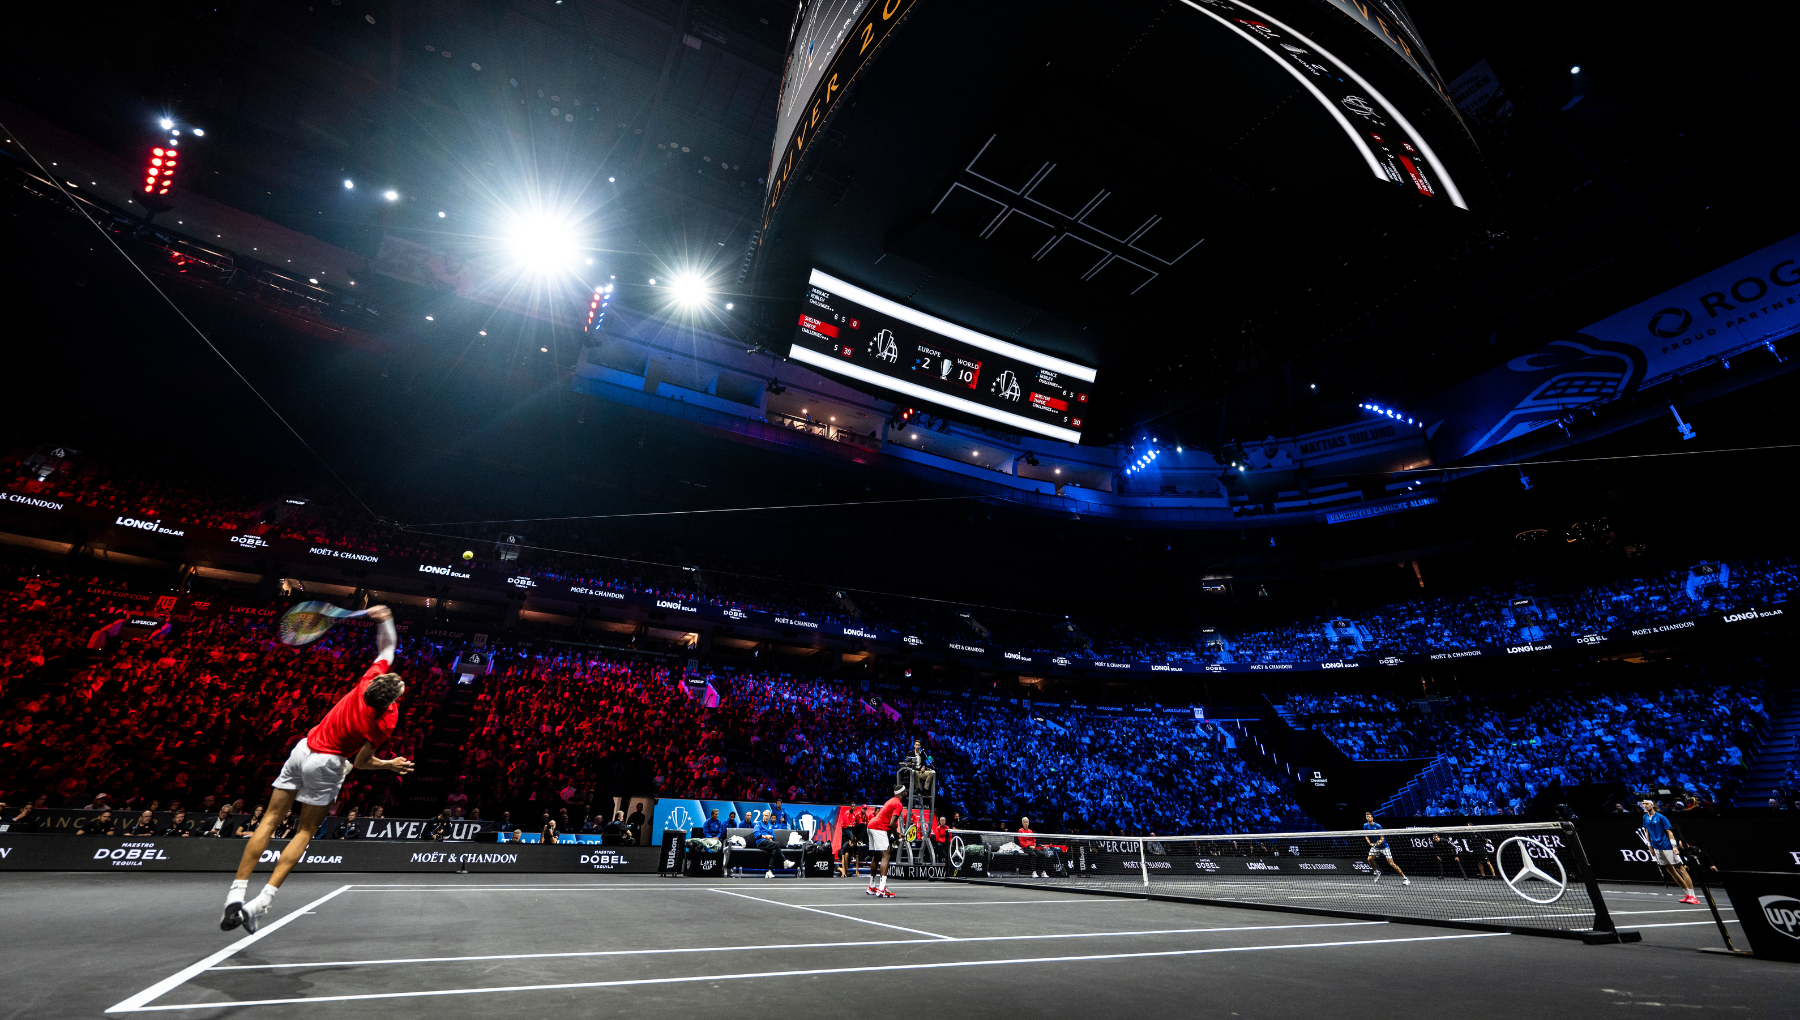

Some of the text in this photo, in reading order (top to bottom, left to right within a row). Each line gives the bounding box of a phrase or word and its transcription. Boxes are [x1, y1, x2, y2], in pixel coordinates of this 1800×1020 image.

[1661, 294, 1800, 354] PROUD PARTNE
[843, 348, 851, 356] 30
[917, 345, 942, 358] EUROPE
[921, 357, 972, 382] 2 10
[957, 358, 979, 370] WORLD
[1300, 425, 1395, 456] MATTIAS OHLUND
[9, 494, 64, 511] CHANDON
[1330, 496, 1438, 521] VANCOUVER CANUCKS ALUMNI
[158, 528, 184, 536] SOLAR
[230, 536, 268, 547] DOBEL
[309, 547, 333, 556] MOËT
[340, 552, 379, 563] CHANDON
[507, 577, 536, 587] DOBEL
[87, 587, 111, 596] LAVER
[594, 590, 624, 599] CHANDON
[160, 598, 175, 607] 115
[229, 605, 276, 617] LAVER CUP
[1760, 609, 1784, 618] SOLAR
[357, 620, 375, 628] CUP
[1659, 620, 1695, 632] CHANDON
[425, 629, 448, 637] LAVER
[753, 809, 761, 823] 2
[1119, 841, 1140, 852] CUP
[1515, 835, 1565, 848] AVER
[93, 848, 168, 860] DOBEL
[410, 852, 518, 863] MOËT & CHANDON
[667, 836, 678, 869] Wilson
[1528, 847, 1556, 858] CUP
[307, 856, 342, 864] SOLAR
[580, 855, 628, 864] DOBEL
